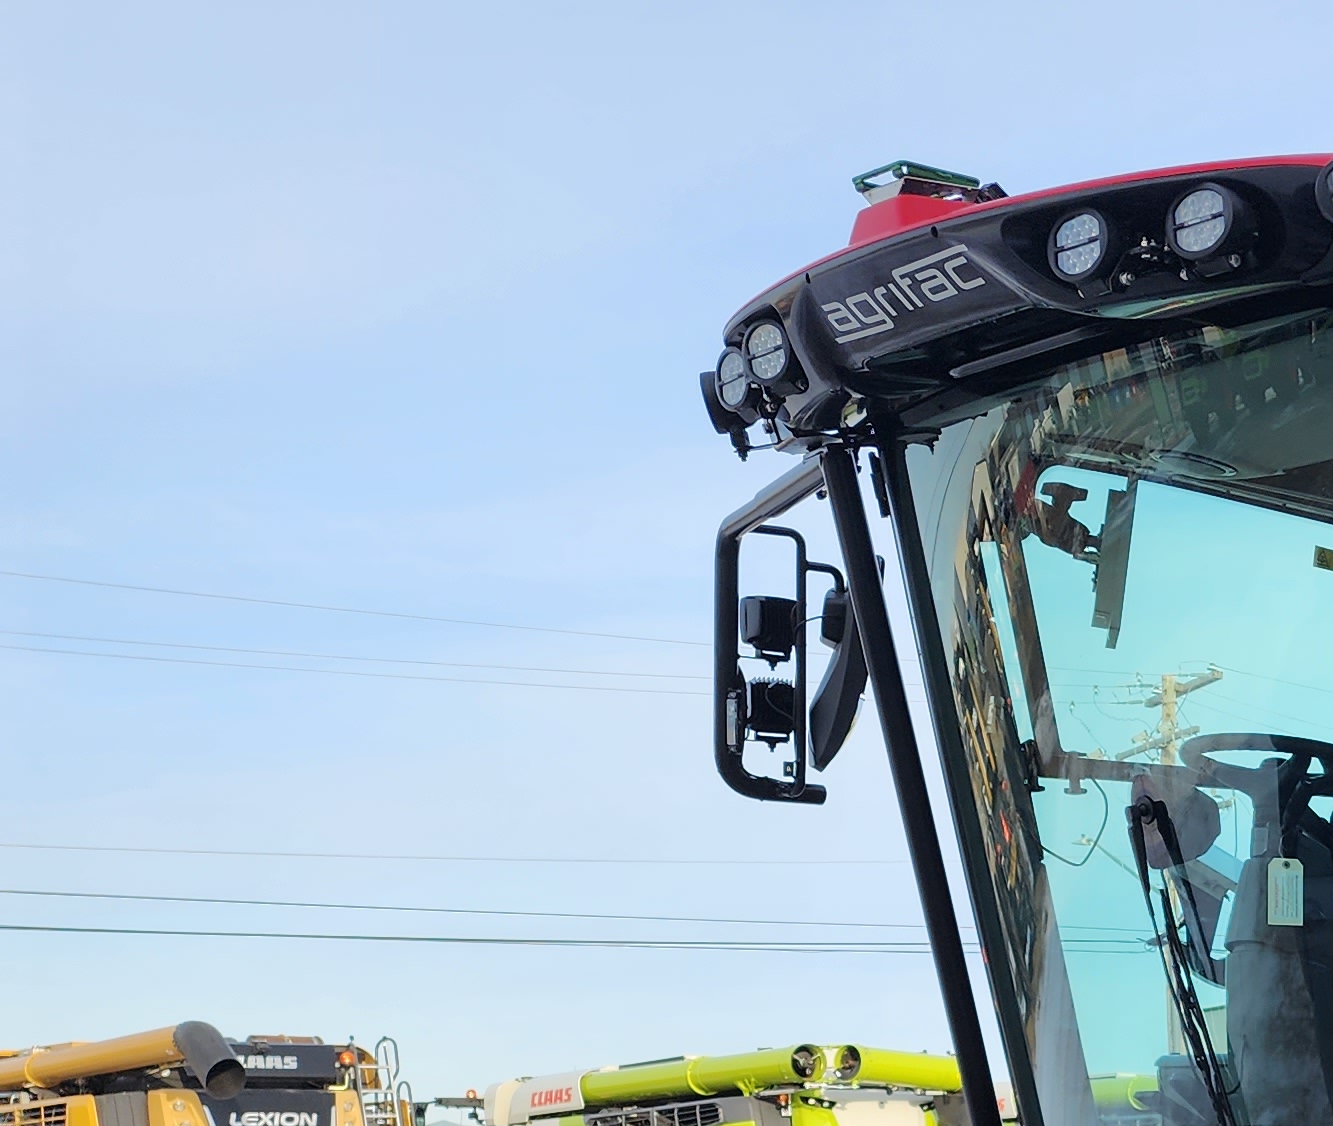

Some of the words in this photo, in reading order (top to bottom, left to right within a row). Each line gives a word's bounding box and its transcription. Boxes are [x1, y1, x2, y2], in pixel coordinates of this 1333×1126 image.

[821, 244, 986, 344] agrifac
[236, 1054, 297, 1069] LAAS
[531, 1087, 573, 1108] CLAAS
